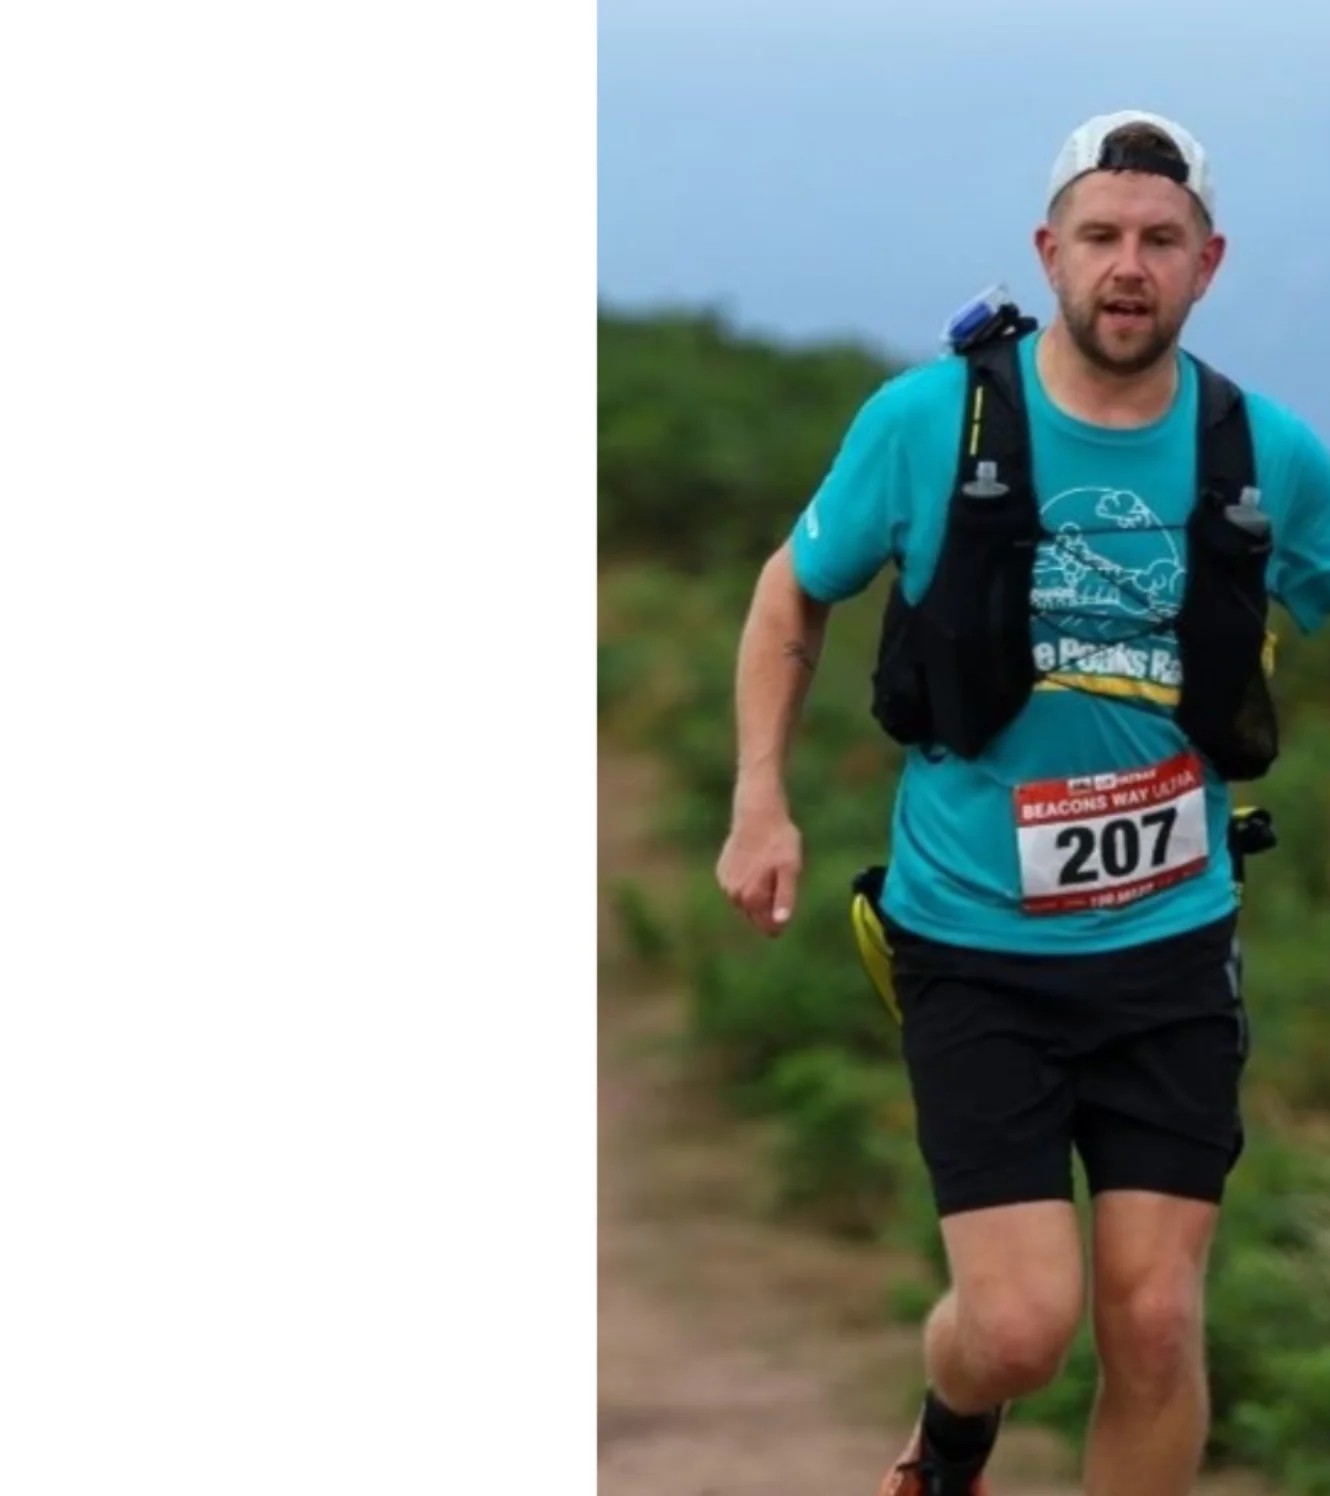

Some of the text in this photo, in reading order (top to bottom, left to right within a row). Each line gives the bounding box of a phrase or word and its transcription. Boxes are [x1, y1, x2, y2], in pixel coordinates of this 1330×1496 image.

[1151, 649, 1184, 685] Ra
[1021, 795, 1108, 820] BEACONS
[1111, 788, 1149, 807] WAY
[1151, 769, 1197, 797] ULTRA
[1055, 807, 1178, 886] 207
